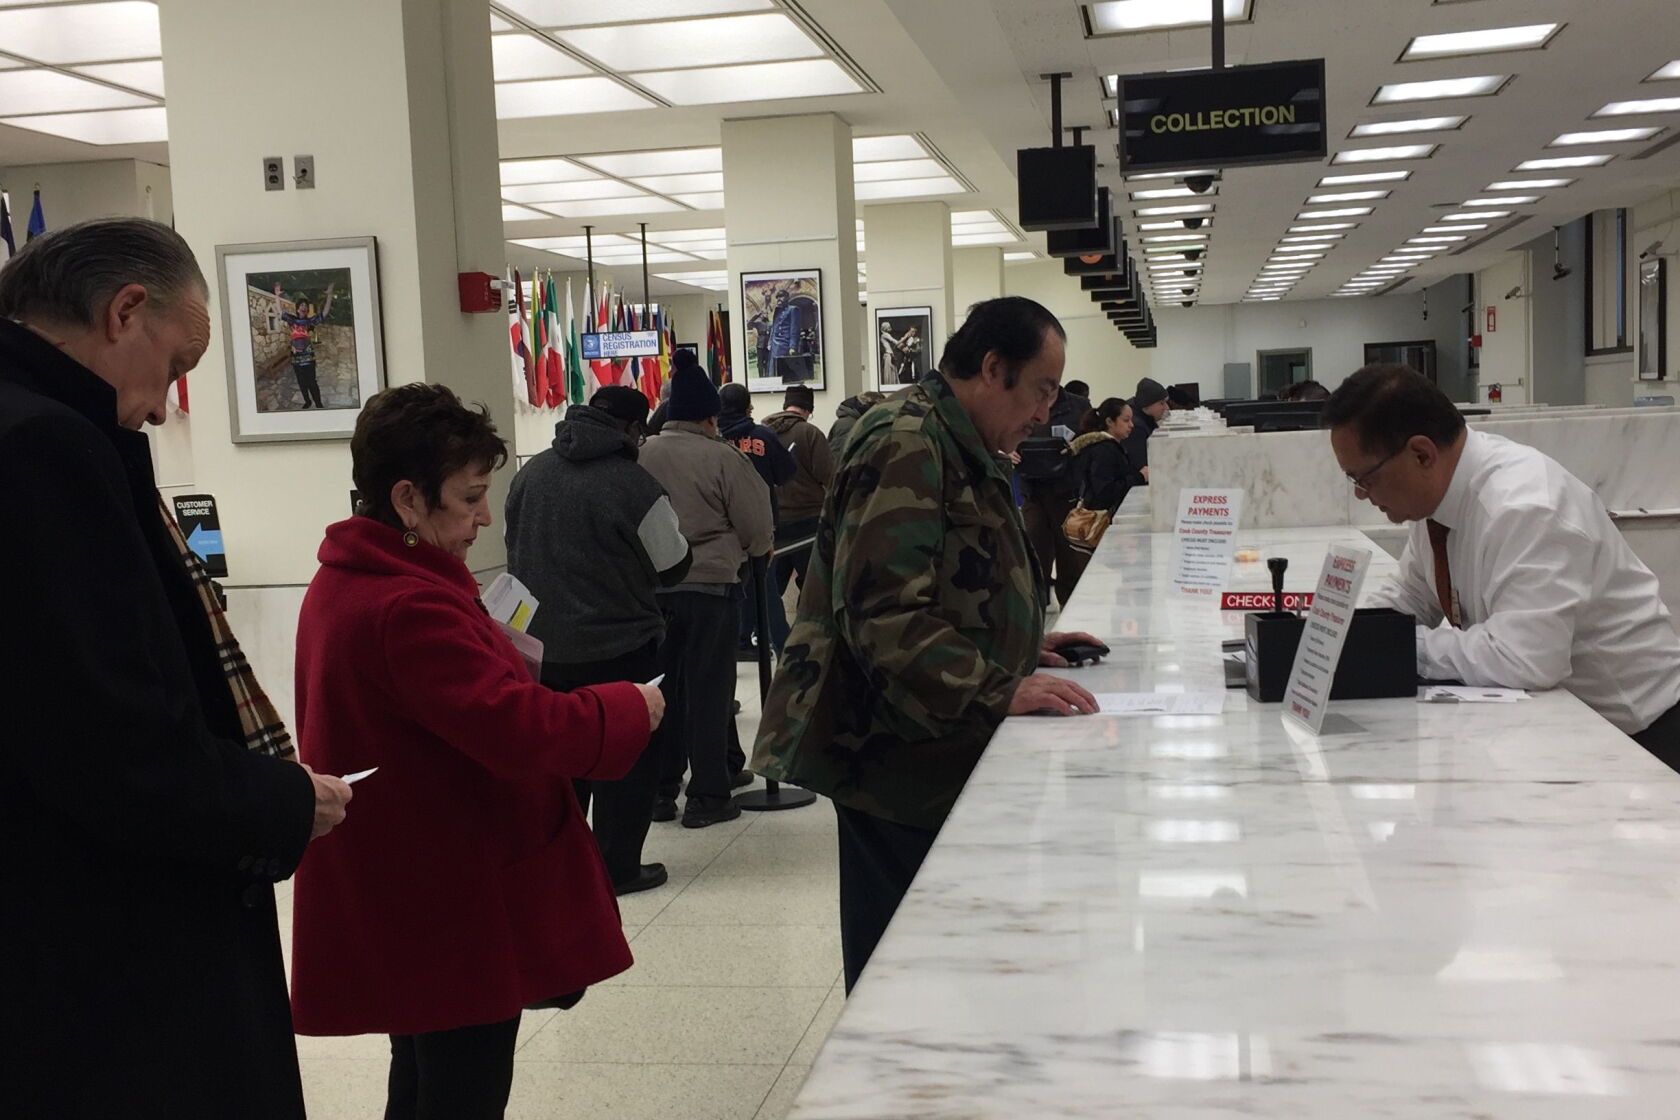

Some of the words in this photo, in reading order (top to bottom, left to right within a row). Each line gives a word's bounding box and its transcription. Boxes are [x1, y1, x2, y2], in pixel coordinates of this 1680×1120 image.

[1150, 105, 1296, 134] COLLECTION
[602, 332, 632, 342] CENSUS
[603, 340, 657, 350] REGISTRATION
[176, 500, 214, 509] CUSTOMER
[1193, 495, 1228, 505] EXPRESS
[182, 508, 211, 517] SERVICE
[1187, 506, 1230, 517] PAYMENTS
[1283, 595, 1312, 607] ONL
